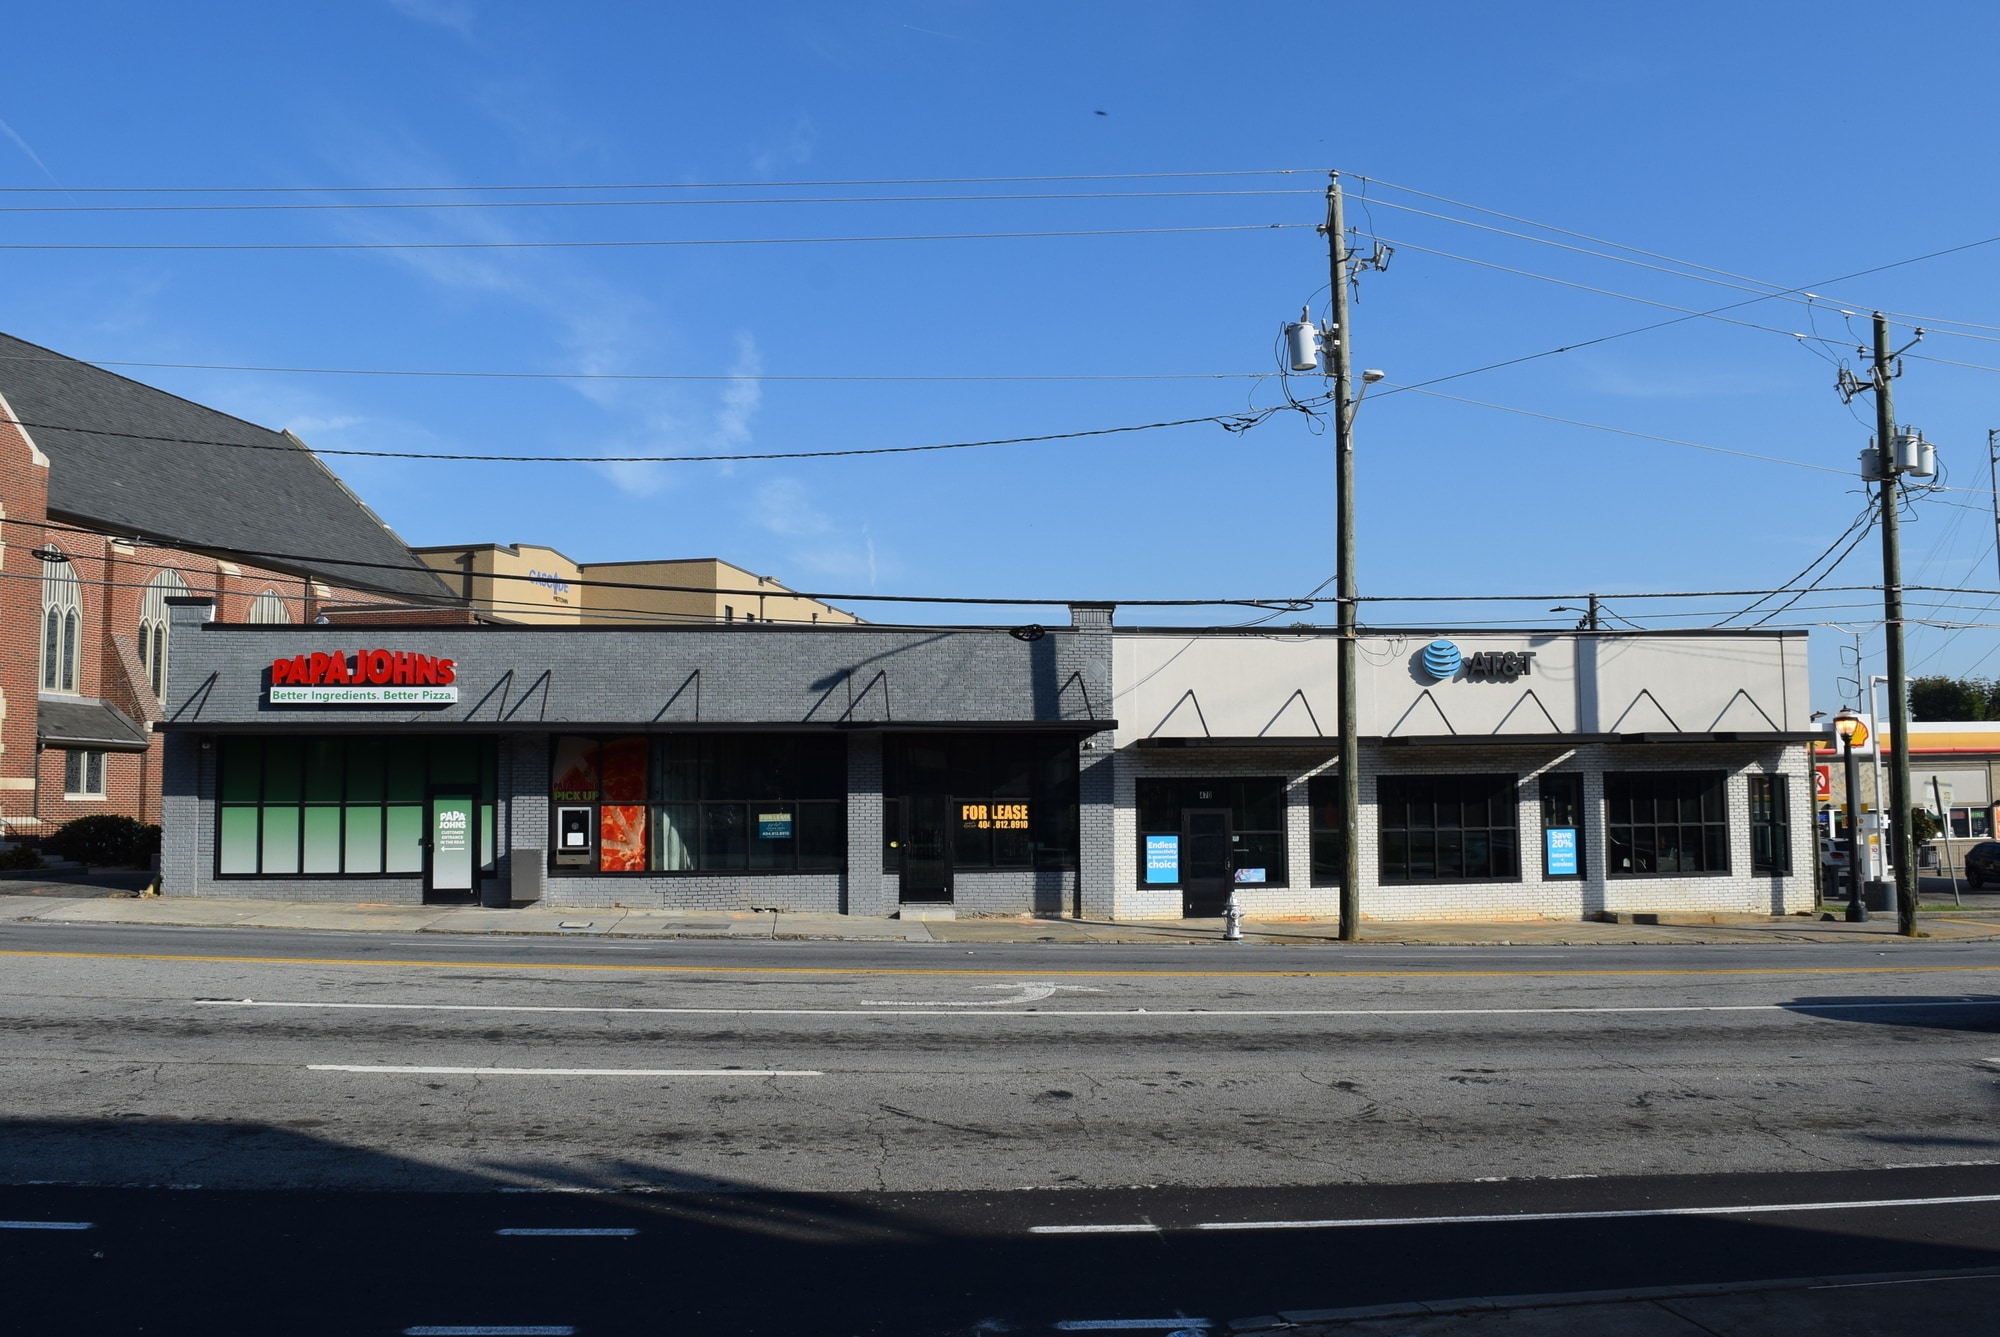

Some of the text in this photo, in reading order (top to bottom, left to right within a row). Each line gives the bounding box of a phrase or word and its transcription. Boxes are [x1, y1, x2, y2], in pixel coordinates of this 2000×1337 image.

[272, 649, 456, 684] PAPA JOHNS
[1469, 652, 1537, 676] AT&T
[272, 690, 455, 702] Better Ingredients. Better Pizza.
[553, 791, 599, 801] PICK UP
[440, 811, 466, 820] PAPA
[962, 805, 1028, 820] FOR LEASE
[1551, 831, 1572, 839] Save
[1147, 841, 1177, 849] Endless
[1551, 839, 1573, 848] 20%
[1147, 860, 1177, 869] choice
